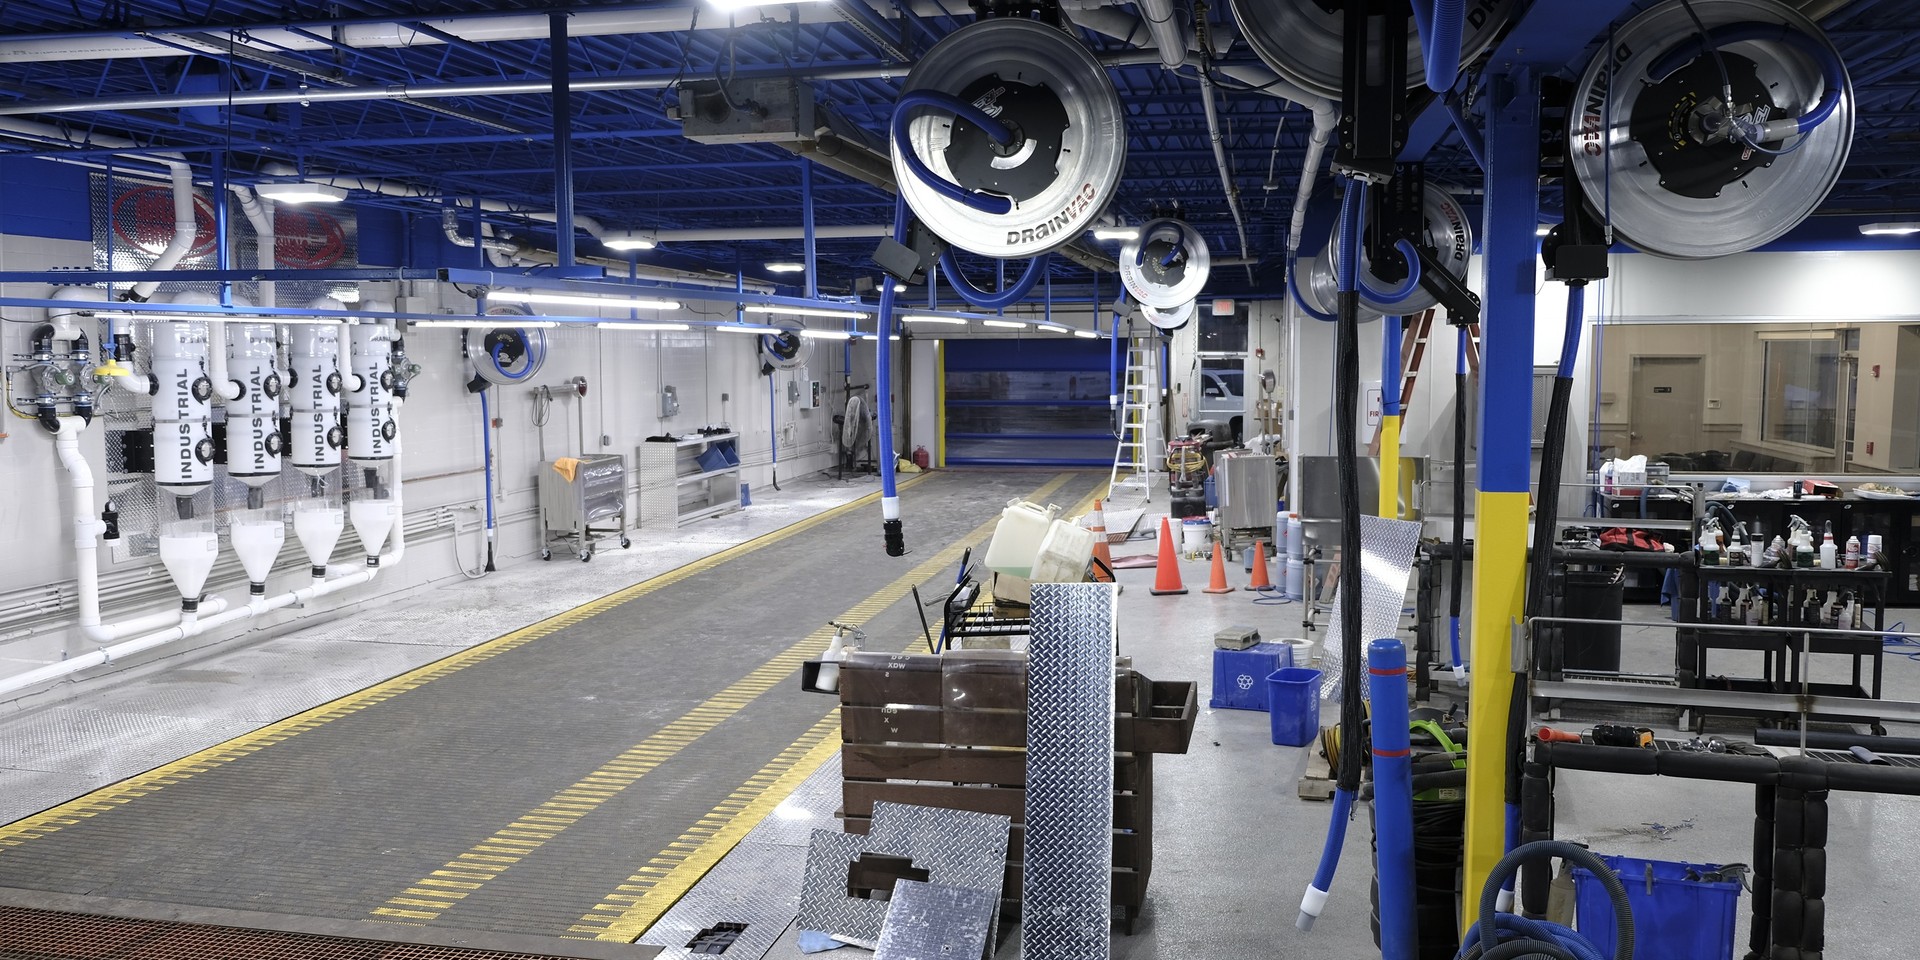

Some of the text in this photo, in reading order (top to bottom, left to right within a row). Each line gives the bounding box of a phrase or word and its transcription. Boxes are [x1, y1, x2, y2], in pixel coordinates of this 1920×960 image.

[177, 368, 193, 478] INDUSTRIAL
[251, 366, 265, 469] INDUSTRIAL
[312, 365, 325, 461] INDUSTRIAL
[369, 362, 382, 454] INDUSTRIAL
